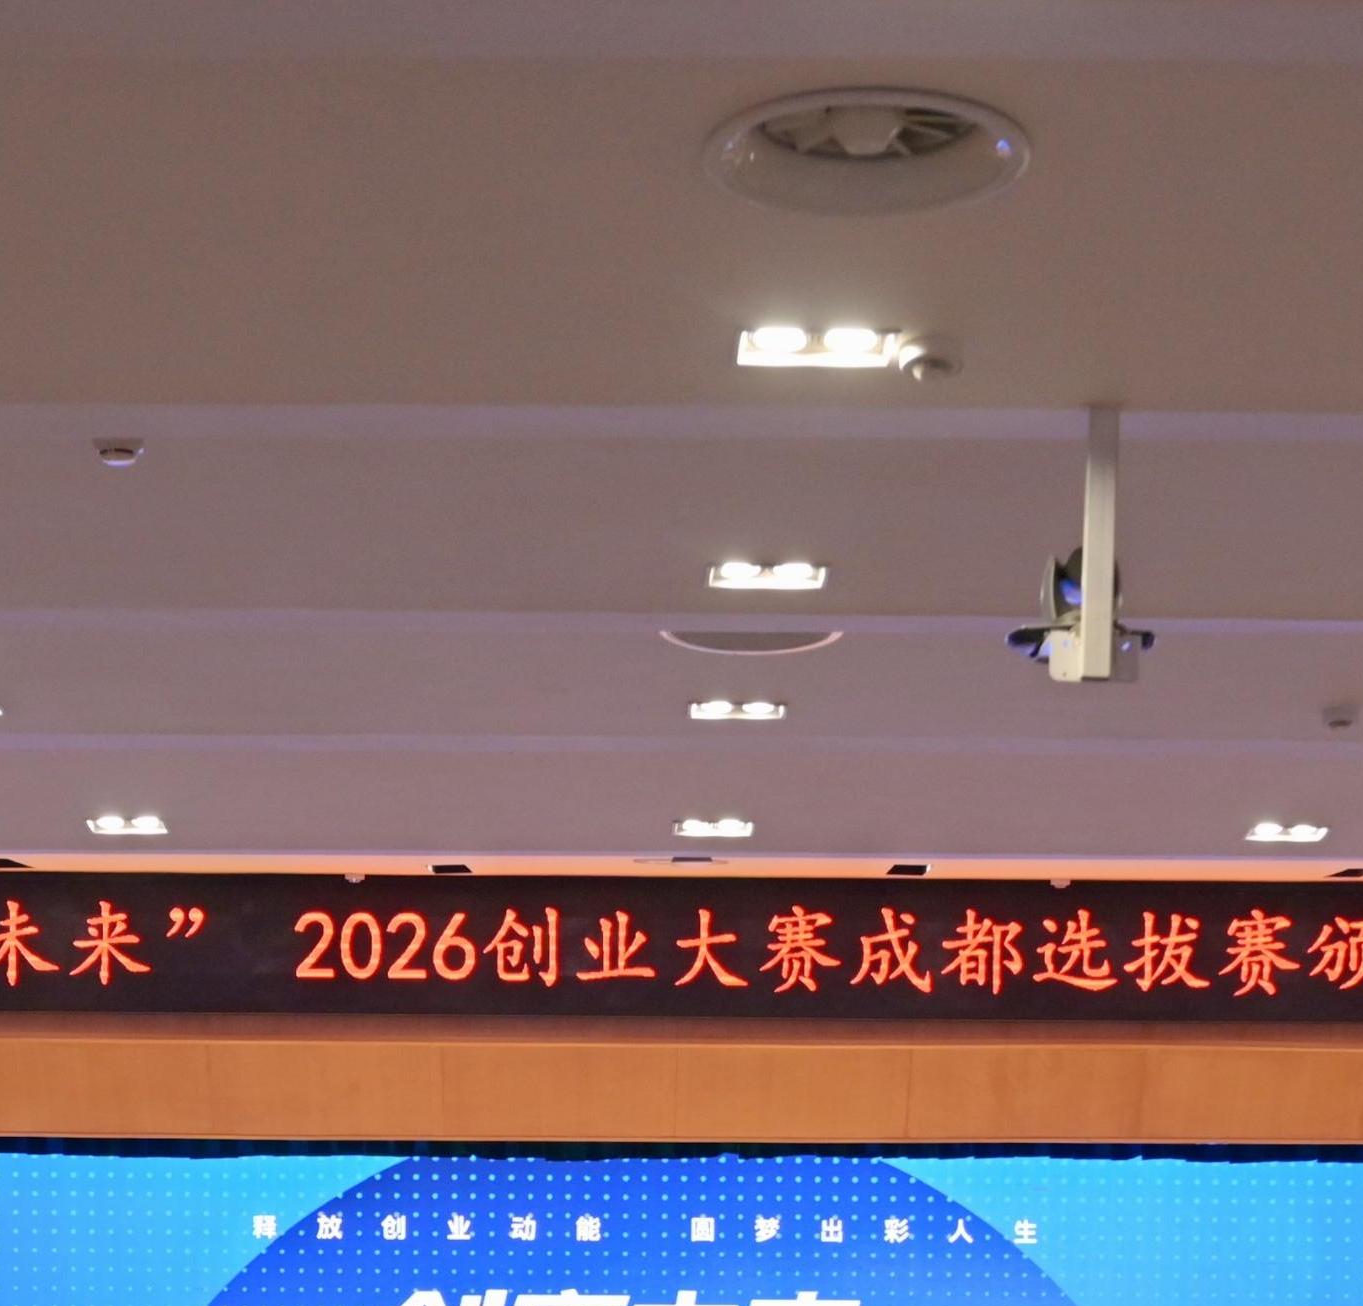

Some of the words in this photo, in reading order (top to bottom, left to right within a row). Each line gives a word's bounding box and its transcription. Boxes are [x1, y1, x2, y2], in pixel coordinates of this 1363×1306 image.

[253, 1214, 601, 1241] 释放创业动能
[691, 1217, 1037, 1244] 圆梦出彩人生
